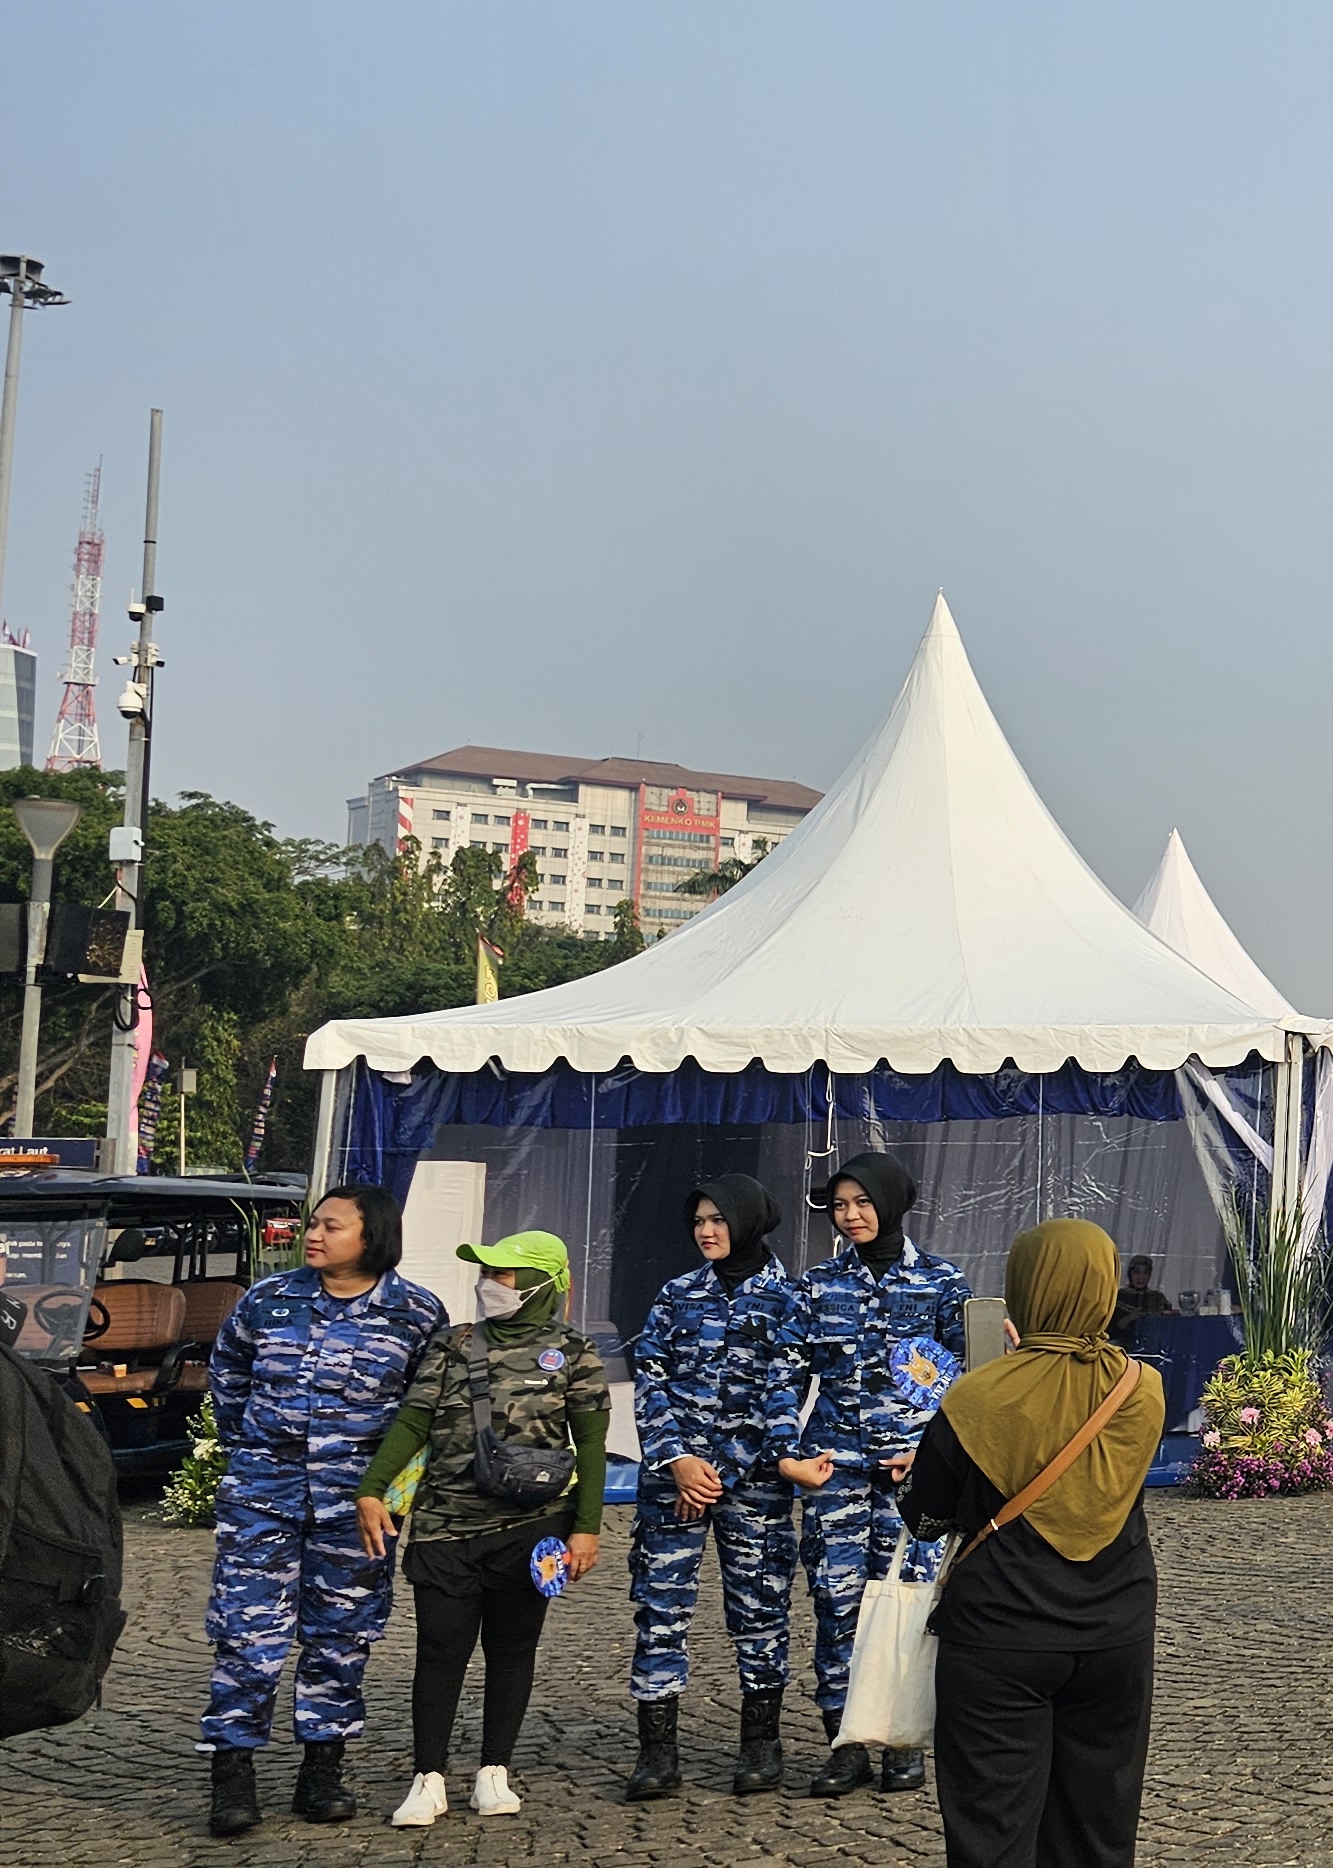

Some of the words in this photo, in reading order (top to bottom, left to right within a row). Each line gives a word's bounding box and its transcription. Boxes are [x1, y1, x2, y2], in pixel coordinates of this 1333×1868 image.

[643, 814, 692, 826] KEMENKO
[694, 818, 716, 829] PMK
[744, 1301, 765, 1311] TNI
[899, 1303, 918, 1311] TNI
[264, 1318, 294, 1327] RIKA
[371, 1325, 394, 1335] TNI
